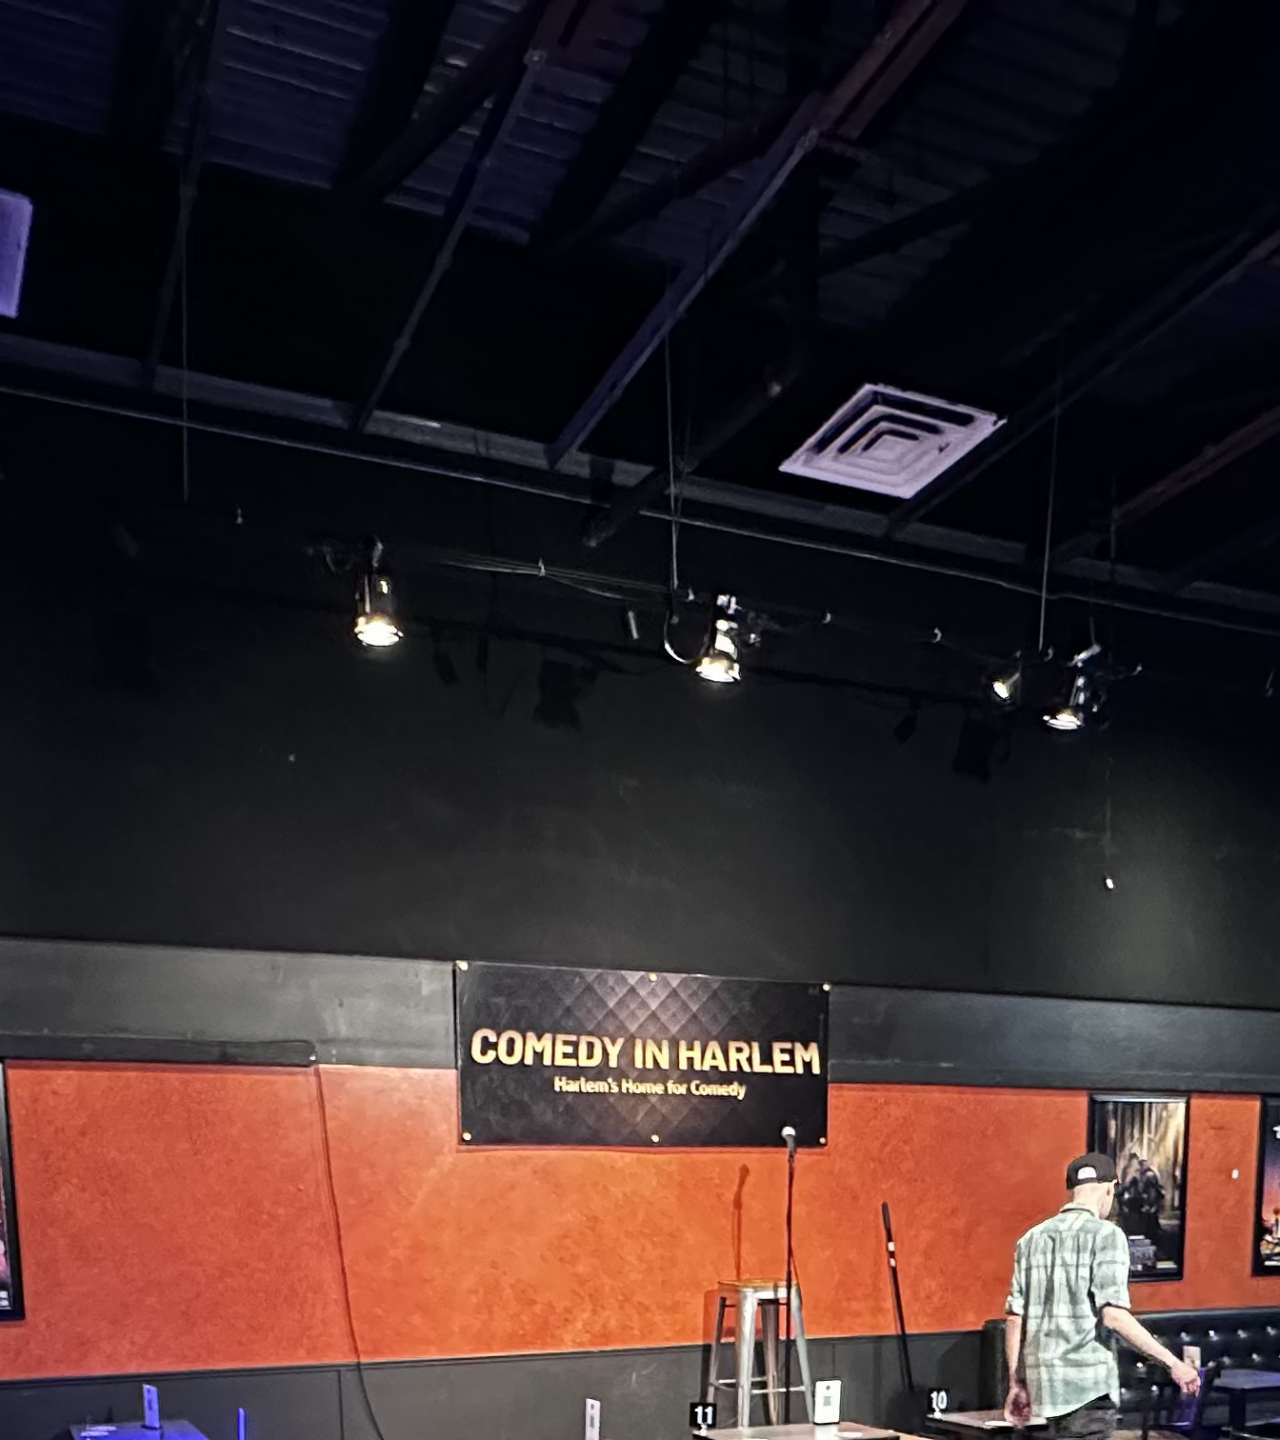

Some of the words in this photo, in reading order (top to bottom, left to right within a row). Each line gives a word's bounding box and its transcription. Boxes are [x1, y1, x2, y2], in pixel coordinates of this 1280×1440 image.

[470, 1028, 625, 1068] COMEDY
[634, 1038, 669, 1070] IN
[678, 1040, 820, 1075] HARLEM
[553, 1076, 619, 1094] Harlem's
[621, 1078, 665, 1095] Home
[667, 1079, 689, 1096] for
[690, 1079, 746, 1101] Comedy
[930, 1390, 948, 1410] 10
[694, 1405, 713, 1425] 11
